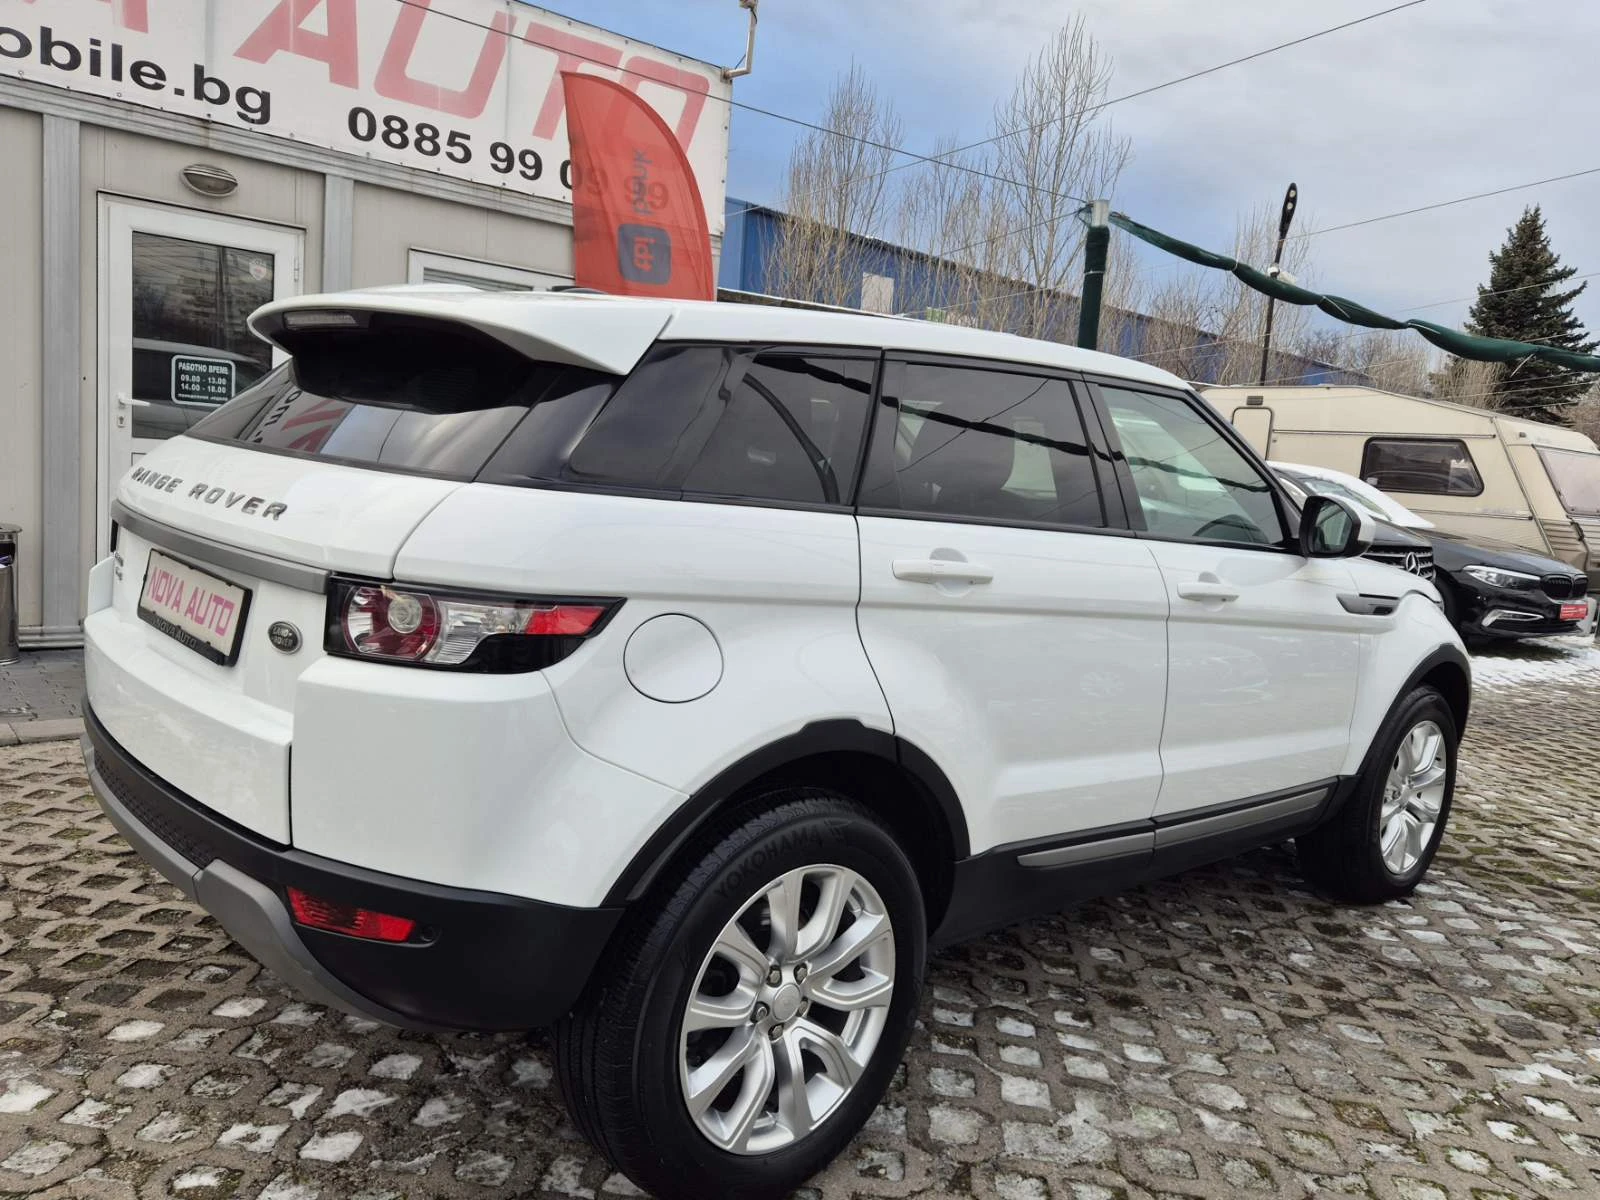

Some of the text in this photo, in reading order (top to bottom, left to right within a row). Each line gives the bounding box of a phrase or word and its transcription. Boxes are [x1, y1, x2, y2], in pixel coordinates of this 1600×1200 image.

[348, 106, 473, 164] 0885
[489, 142, 543, 181] 99
[178, 362, 207, 373] РАБОТНО
[180, 383, 200, 391] 14.00
[131, 466, 288, 521] RANGE ROVER
[147, 565, 185, 613] NOVA
[184, 585, 236, 637] AUTO
[176, 629, 197, 648] AUTO
[714, 824, 824, 899] YOKOHAMA
